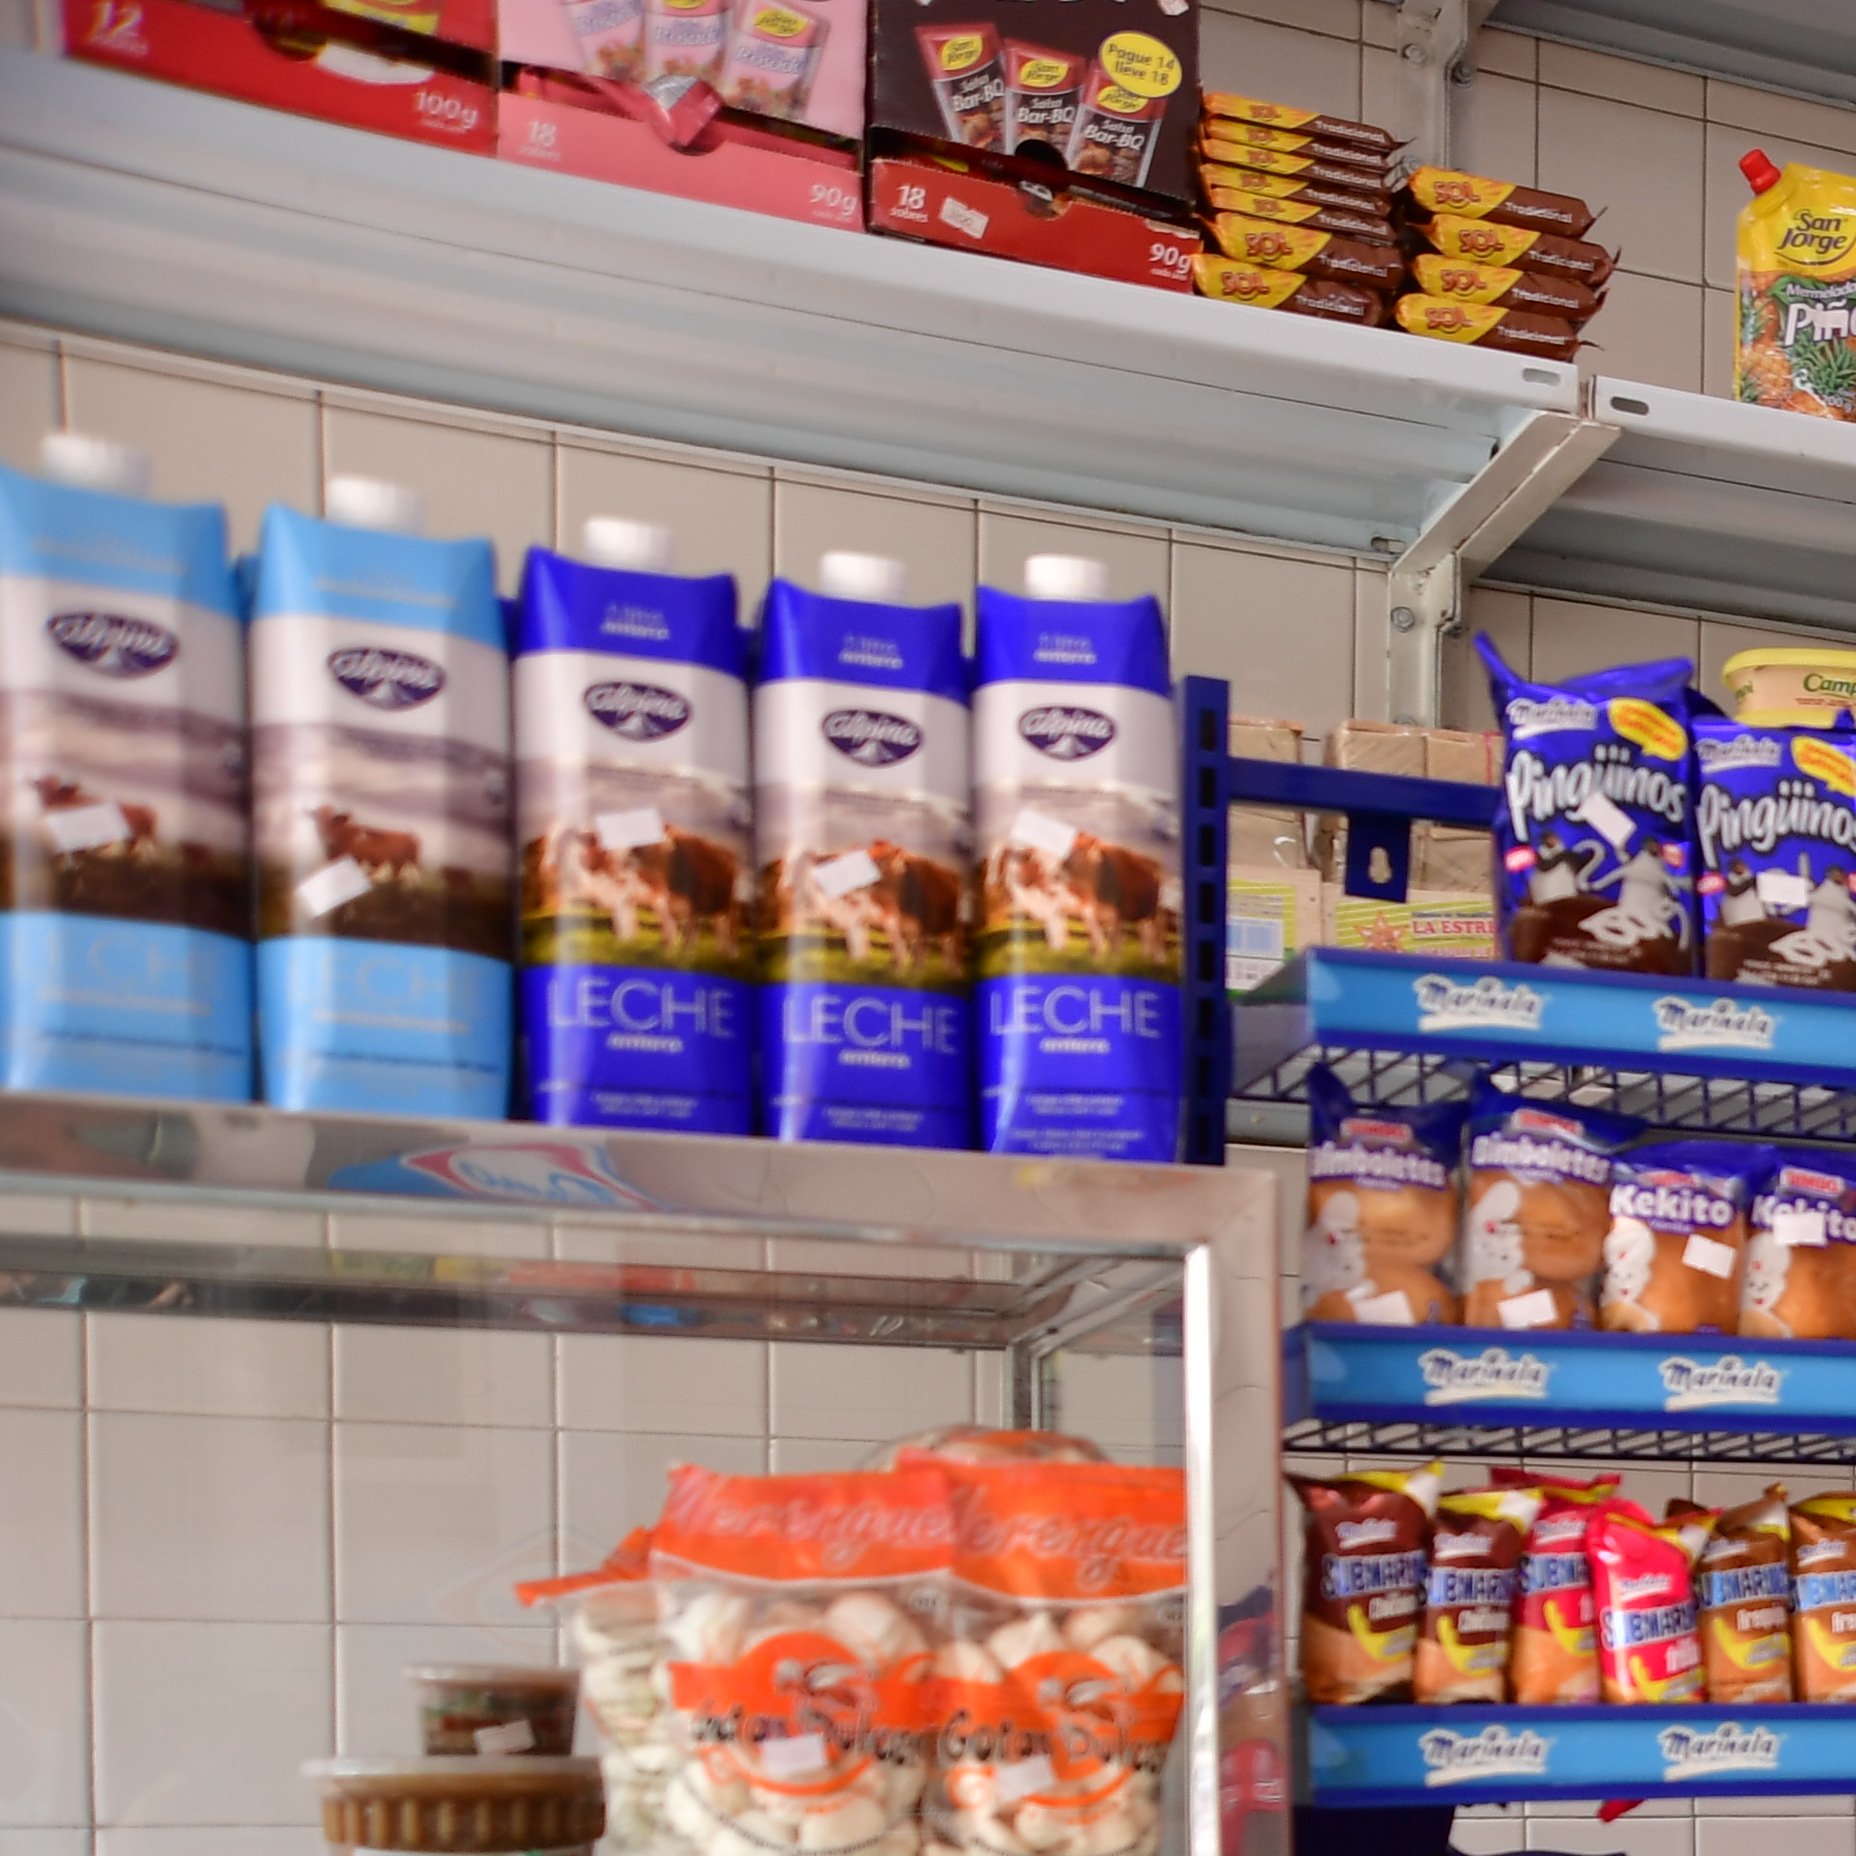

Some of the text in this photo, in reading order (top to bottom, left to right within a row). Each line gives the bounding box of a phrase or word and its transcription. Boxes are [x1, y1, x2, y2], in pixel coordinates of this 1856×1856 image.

[1109, 43, 1152, 67] Pague
[1114, 61, 1147, 80] lleve
[414, 90, 478, 130] 100g
[1017, 107, 1075, 125] Bar-BQ
[527, 119, 558, 148] 18
[1084, 123, 1145, 150] Bar-BQ
[1315, 119, 1385, 143] Tradicional
[1312, 142, 1383, 166] Tradicional
[1311, 164, 1382, 189] Tradicional
[810, 182, 858, 217] 90g
[896, 184, 927, 212] 18
[1305, 187, 1376, 211] Tradicional
[1434, 181, 1573, 224] SOL Tradicional
[1317, 212, 1387, 235] Tradicional
[1776, 226, 1848, 253] Jorge
[1793, 210, 1843, 234] San
[1149, 241, 1192, 276] 90g
[1246, 231, 1387, 278] SOL Tradicional
[1458, 229, 1594, 272] SOL Tradicional
[1222, 271, 1365, 316] SOL Tradicional
[1441, 269, 1579, 309] SOL Tradicional
[1425, 306, 1569, 346] SOL Tradicional
[1505, 744, 1687, 842] Pingüinos
[1412, 921, 1436, 935] LA
[547, 978, 737, 1040] LECHE
[989, 984, 1163, 1040] LECHE
[1412, 974, 1543, 1018] Marinela
[782, 996, 959, 1054] LECHE
[1653, 995, 1775, 1042] Marinela
[1608, 1183, 1734, 1227] Kekito
[1418, 1347, 1547, 1390] Marinela
[1658, 1355, 1782, 1396] Marinela
[1418, 1726, 1547, 1772] Marinela
[1660, 1722, 1779, 1765] Marinela
